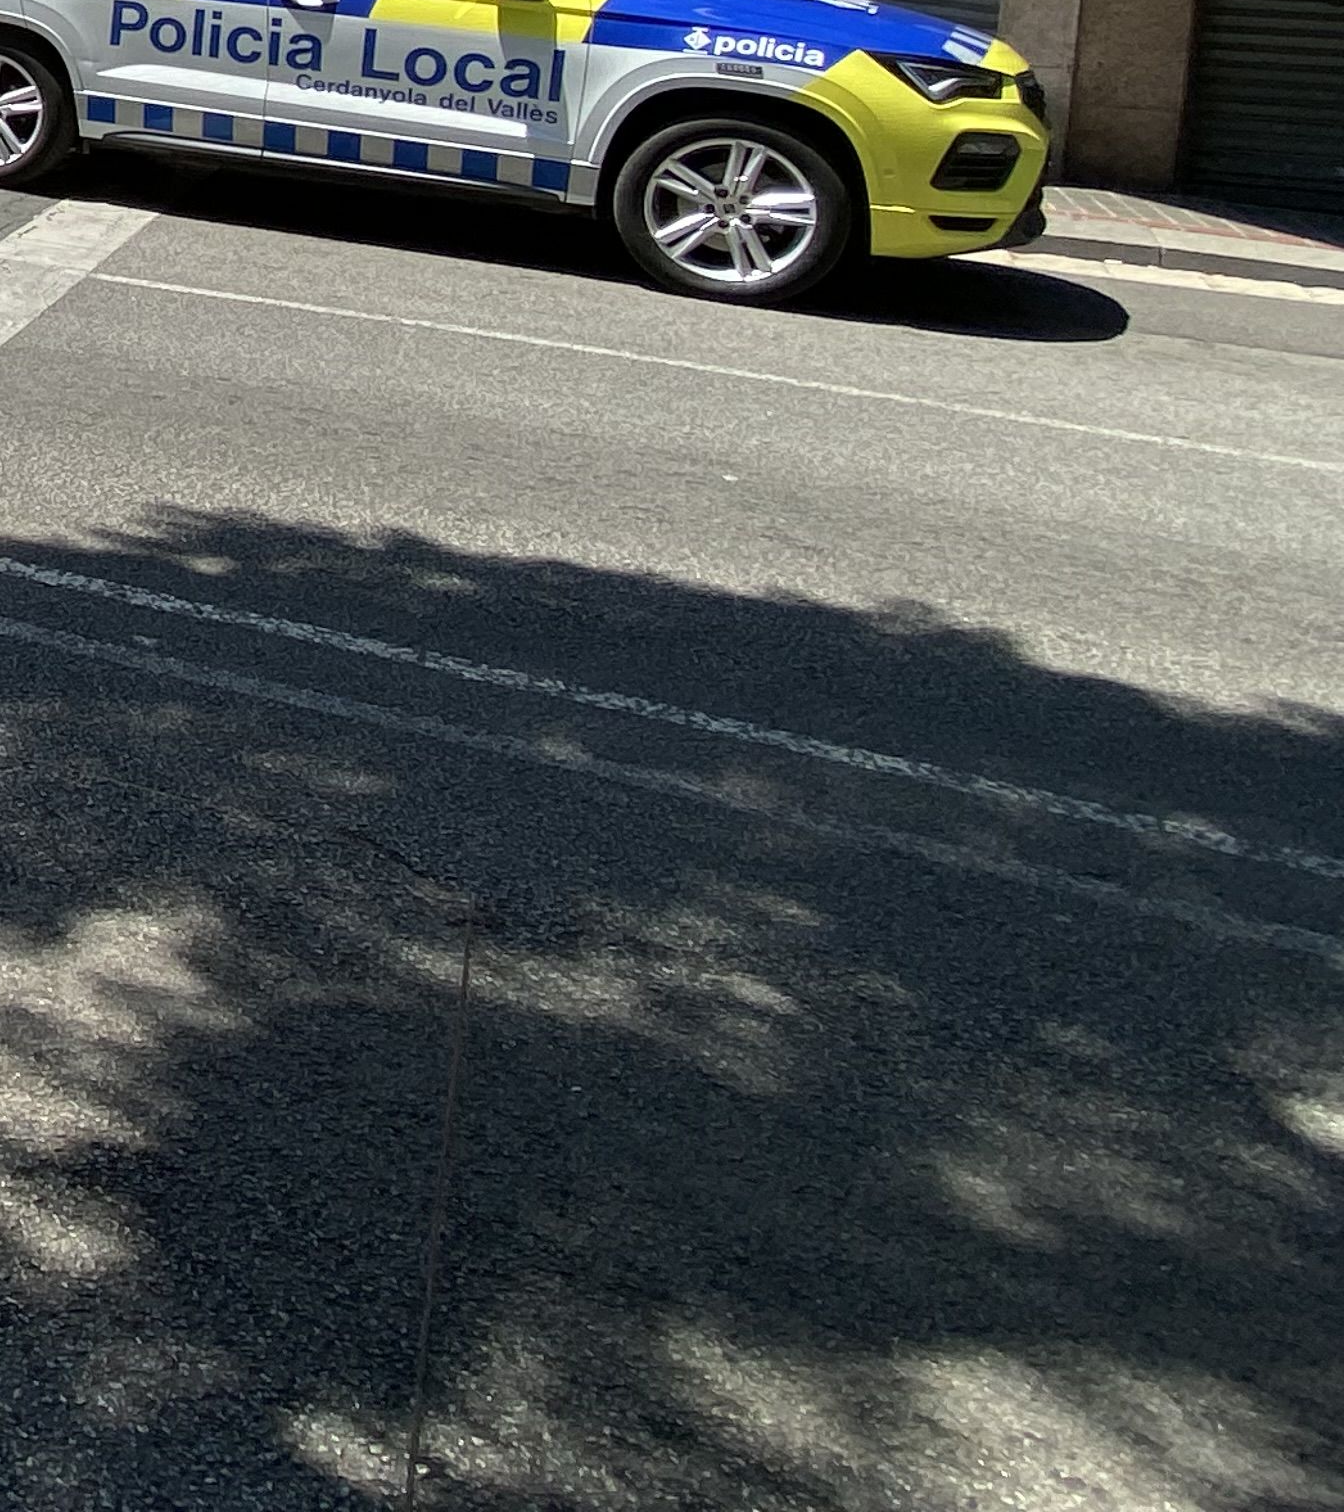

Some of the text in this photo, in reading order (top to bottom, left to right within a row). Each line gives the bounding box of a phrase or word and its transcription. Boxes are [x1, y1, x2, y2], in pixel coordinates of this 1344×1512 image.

[109, 0, 566, 102] Policia Local
[714, 35, 825, 68] policia
[295, 73, 558, 125] Cerdanyola del Vallès
